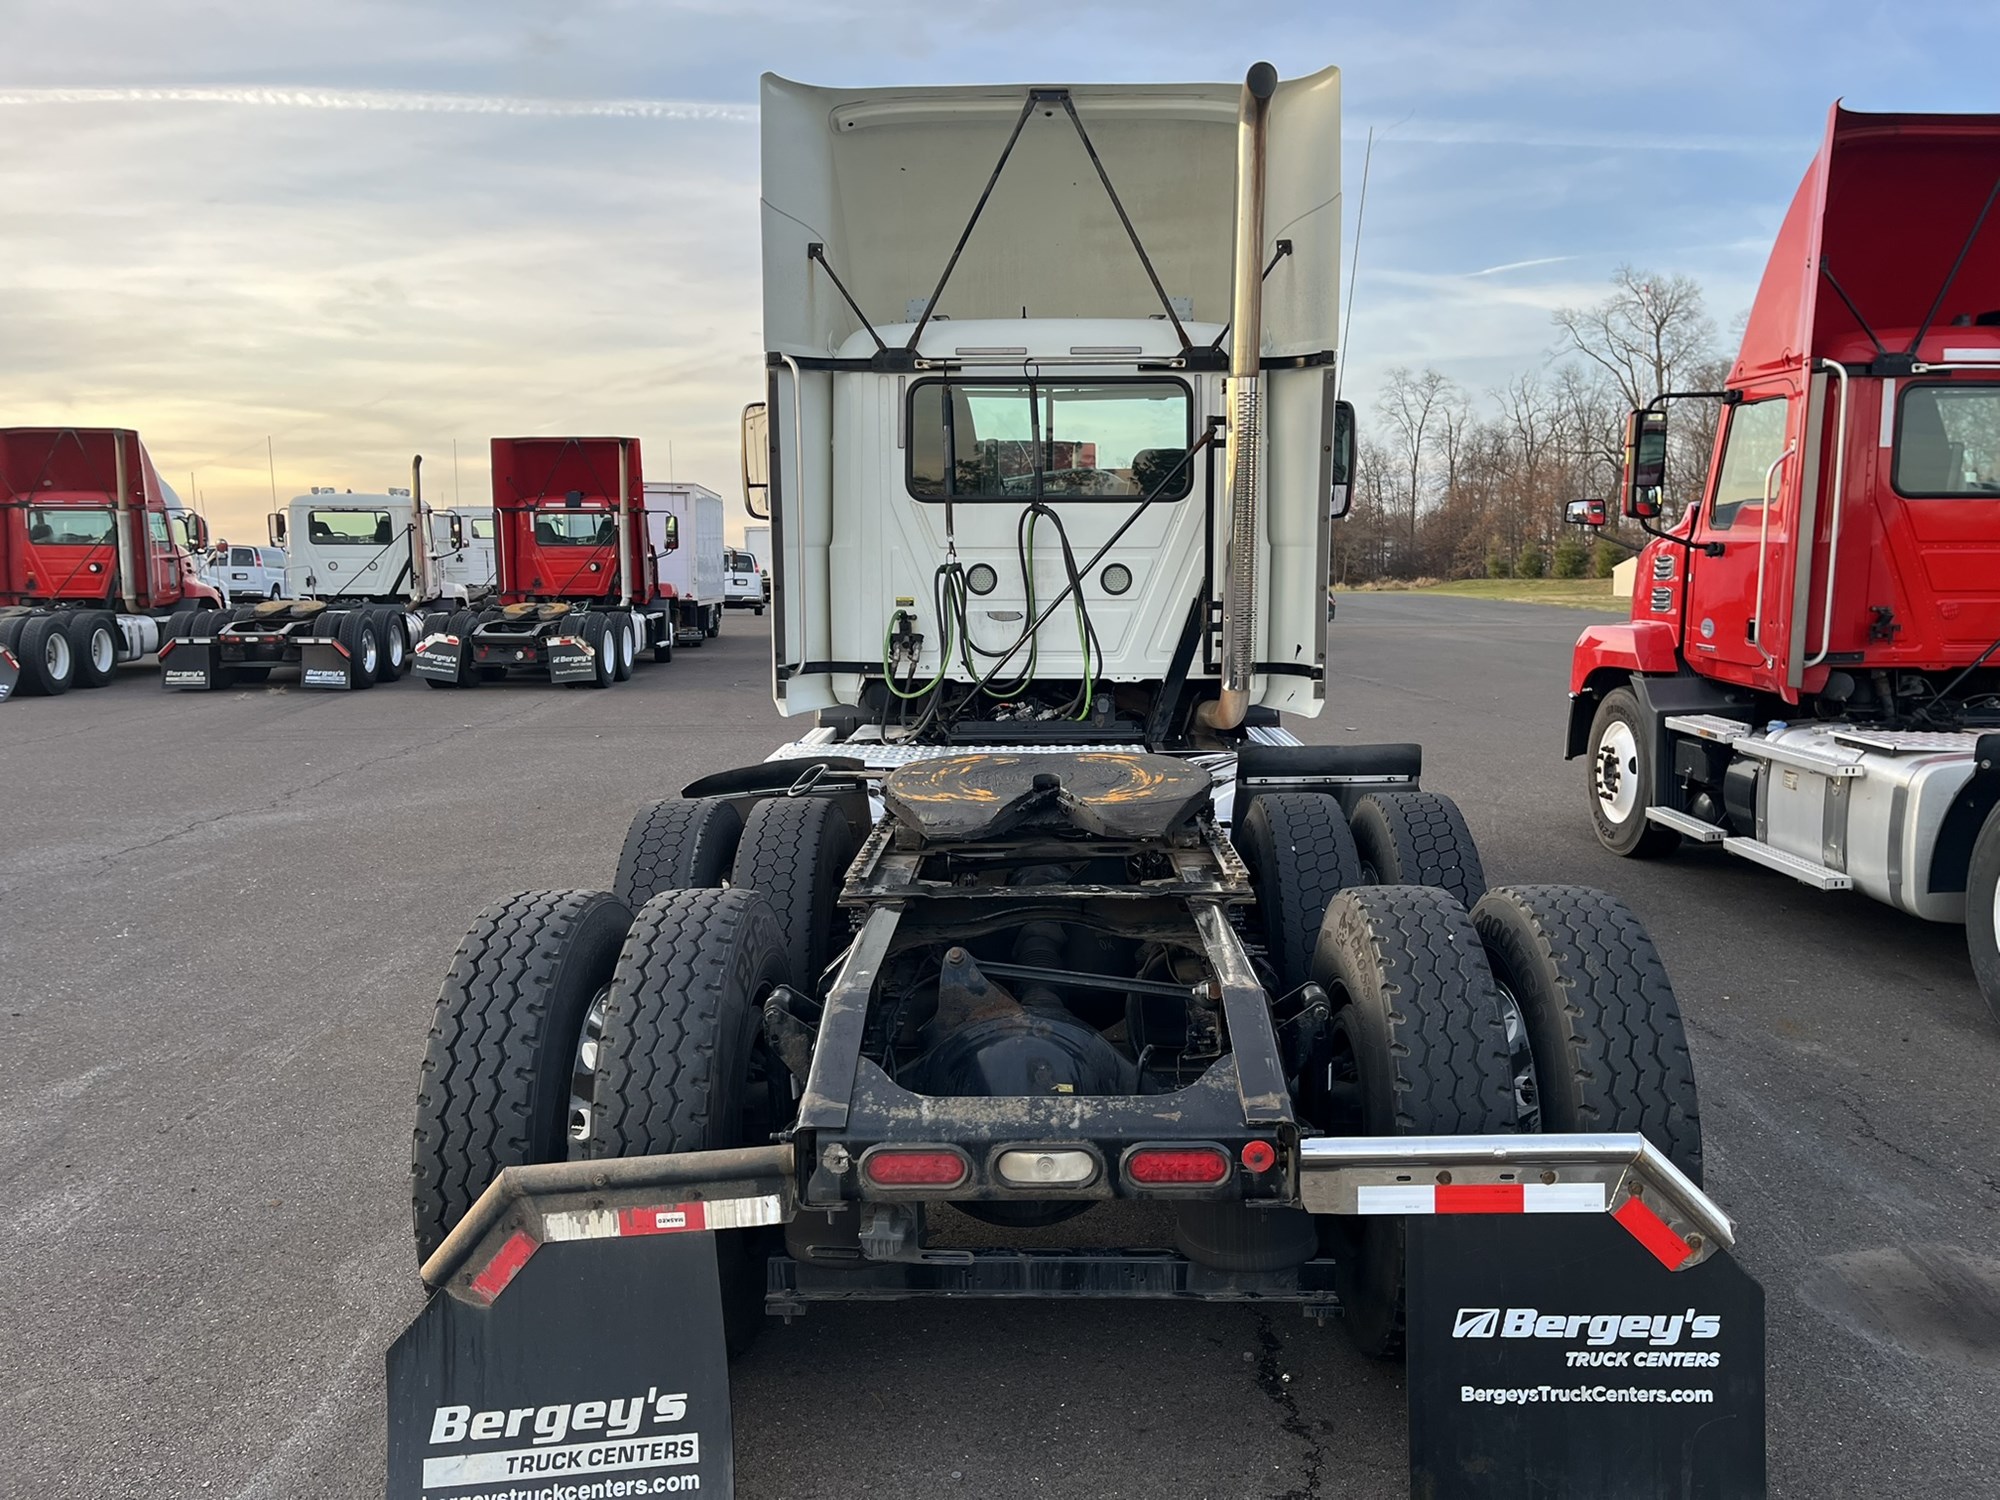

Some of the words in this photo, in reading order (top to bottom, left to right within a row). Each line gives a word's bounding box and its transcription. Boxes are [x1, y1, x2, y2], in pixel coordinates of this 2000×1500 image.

[1500, 1308, 1721, 1346] Bergey's
[1565, 1351, 1631, 1368] TRUCK
[1633, 1351, 1721, 1368] CENTERS
[1460, 1385, 1714, 1405] BergeysTruckCenters.com
[428, 1386, 688, 1445] Bergey's
[506, 1449, 582, 1475] TRUCK
[587, 1439, 695, 1467] CENTERS
